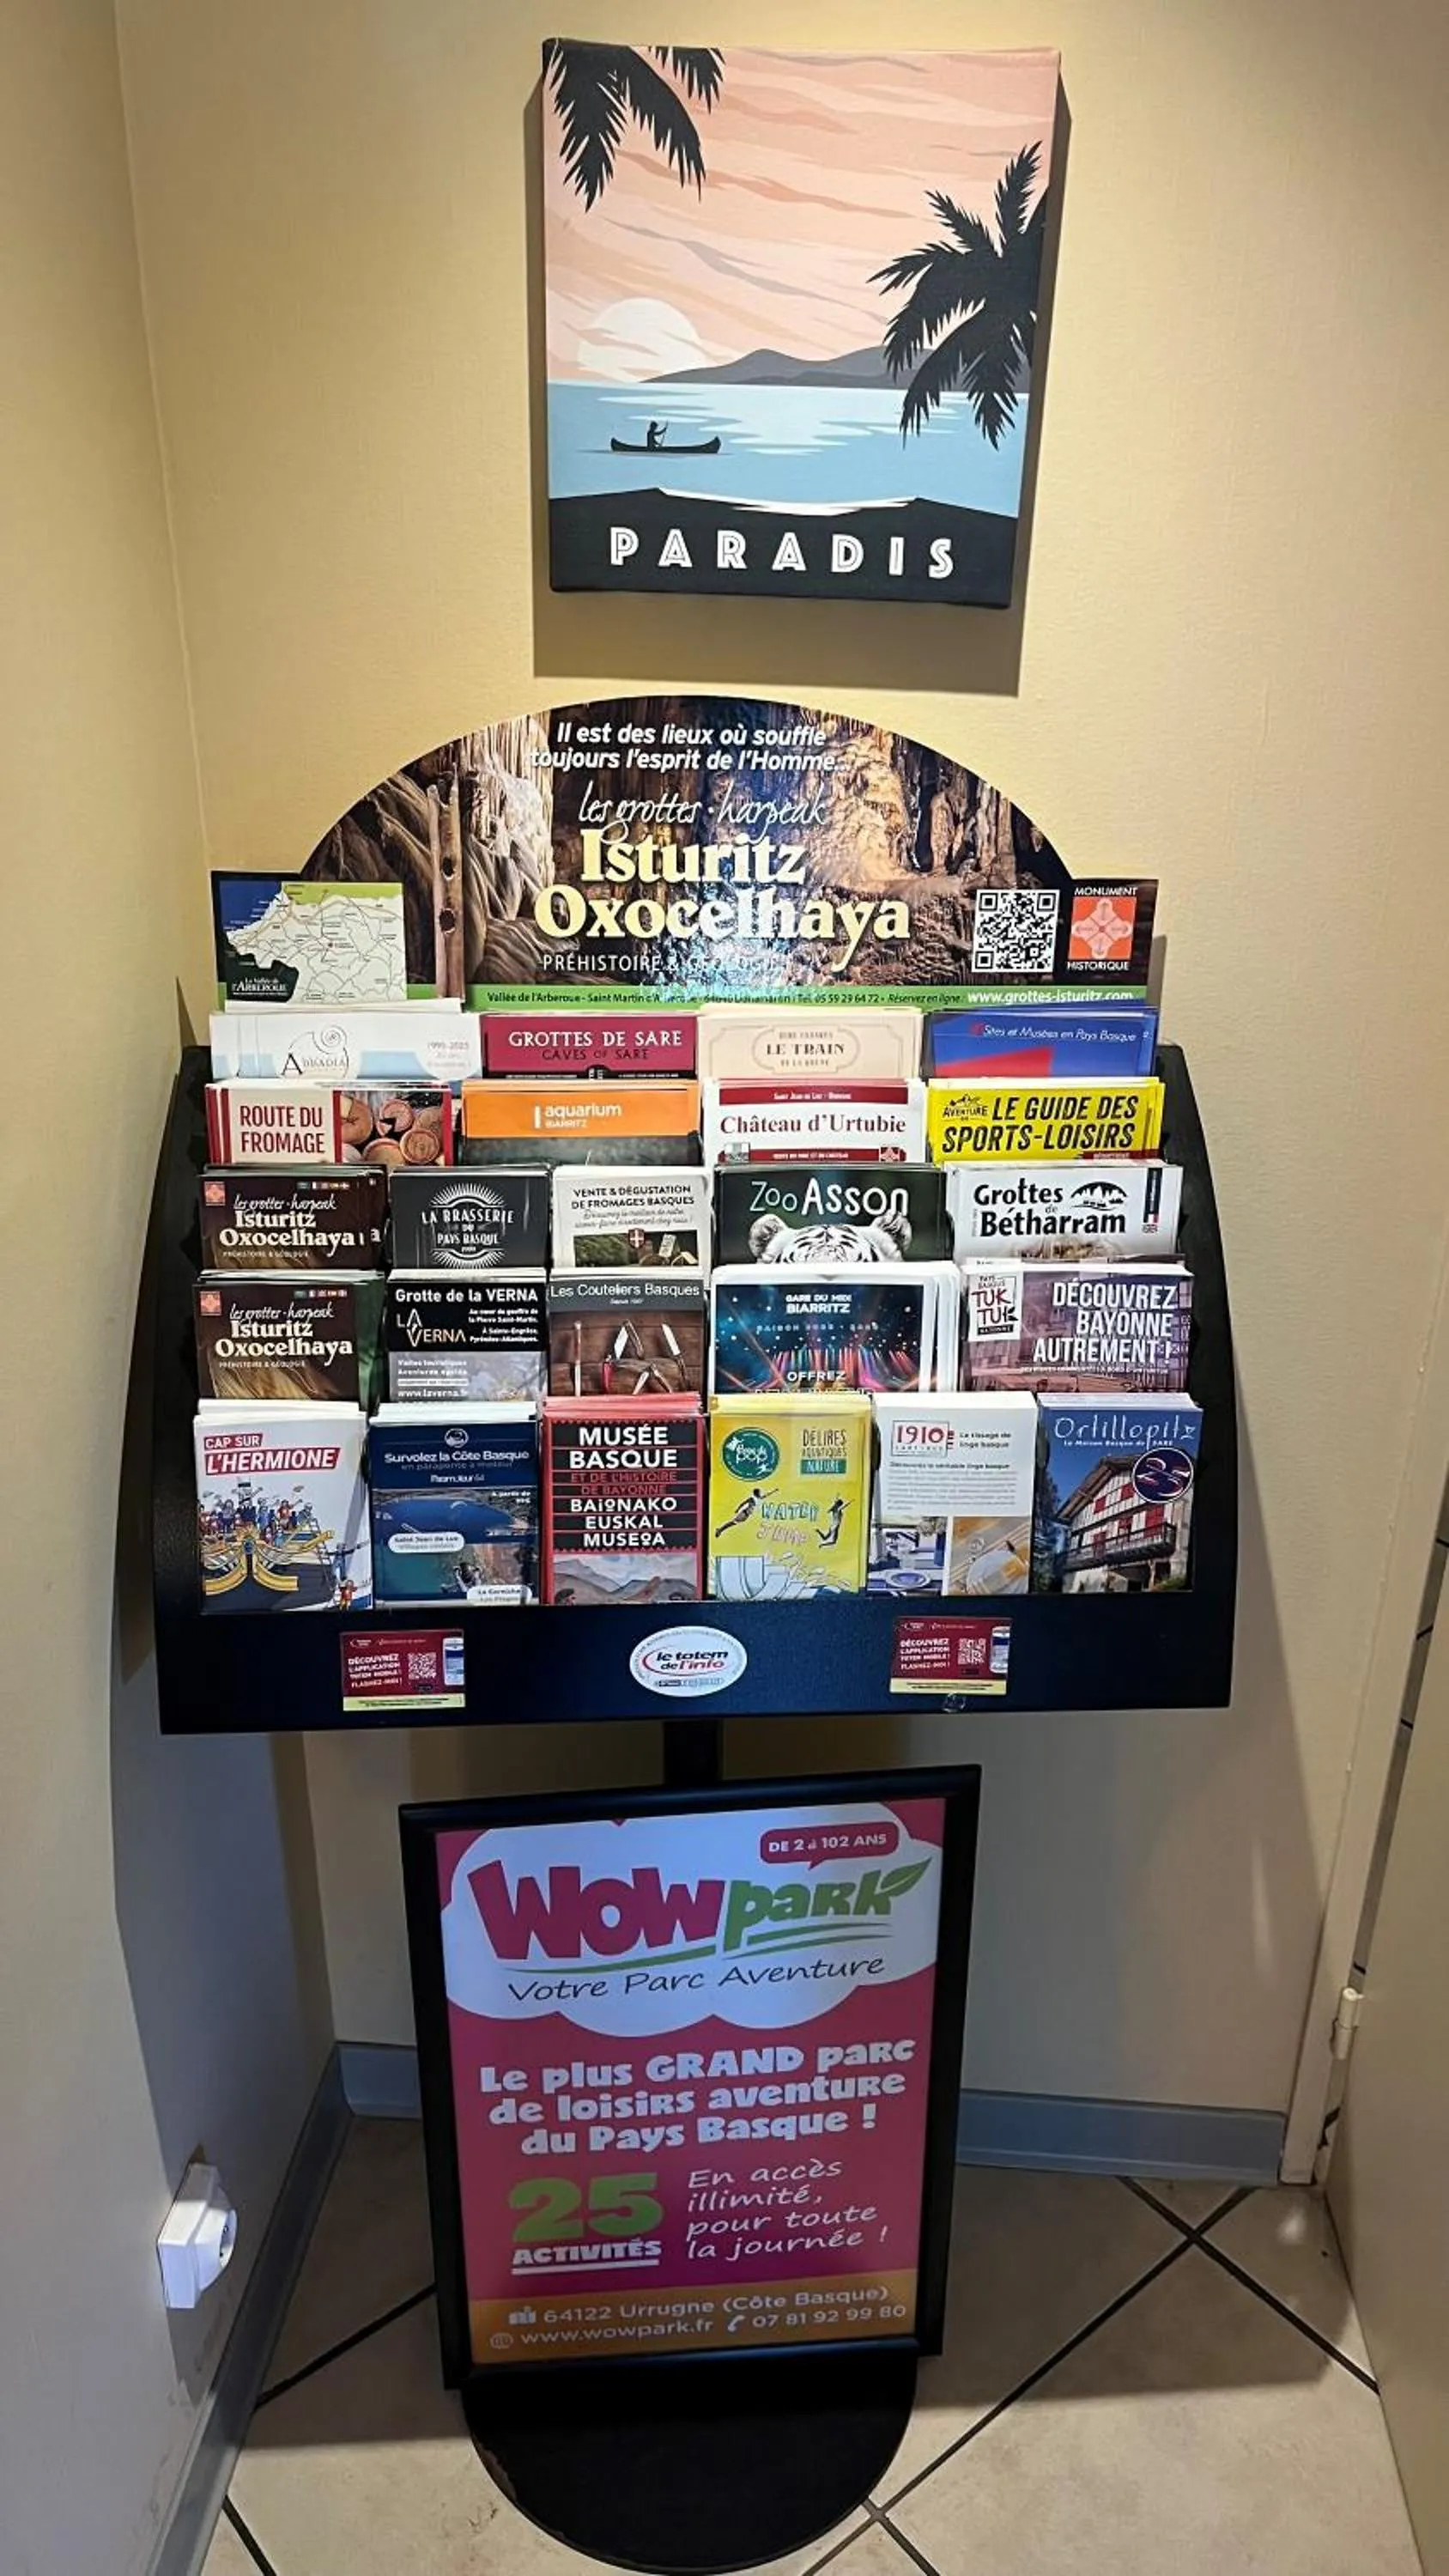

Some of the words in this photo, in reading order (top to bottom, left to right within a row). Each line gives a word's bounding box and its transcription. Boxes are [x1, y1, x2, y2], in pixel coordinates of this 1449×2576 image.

[610, 526, 954, 579] PARADIS
[557, 723, 570, 744] Il
[576, 726, 611, 744] est
[617, 724, 656, 744] des
[662, 724, 712, 745] lieux
[720, 726, 748, 745] où
[752, 726, 827, 747] souffle
[530, 749, 620, 772] toujours
[626, 750, 700, 772] l'esprit
[706, 751, 732, 770] de
[579, 781, 609, 823] les
[602, 792, 702, 845] grottes
[718, 779, 828, 846] harpeak
[580, 829, 806, 884] Isturitz
[1075, 886, 1137, 896] MONUMENT
[534, 885, 911, 973] Oxocelhaya
[543, 952, 661, 972] PRÉHISTOIRE
[1067, 961, 1129, 971] HISTORIQUE
[488, 992, 516, 1002] Vallée
[518, 992, 530, 1002] de
[588, 993, 611, 1003] Saint
[614, 993, 644, 1004] Martin
[828, 993, 839, 1003] 59
[868, 994, 879, 1004] 72
[967, 989, 1133, 1005] www.grottes-isturitz.com
[508, 1031, 592, 1047] GROTTES
[603, 1031, 625, 1047] DE
[634, 1030, 682, 1046] SARE
[1008, 1028, 1017, 1036] et
[1076, 1029, 1097, 1042] Pays
[1100, 1030, 1137, 1042] Basque
[542, 1049, 586, 1060] CAVES
[615, 1048, 649, 1060] SARE
[767, 1044, 786, 1055] LE
[791, 1044, 845, 1055] TRAIN
[239, 1106, 298, 1127] ROUTE
[300, 1107, 323, 1127] DU
[544, 1103, 622, 1118] aquarium
[992, 1097, 1019, 1121] LE
[1025, 1097, 1091, 1121] GUIDE
[1096, 1096, 1138, 1120] DES
[720, 1115, 801, 1134] Château
[809, 1114, 906, 1133] d'Urtubie
[240, 1132, 325, 1153] FROMAGE
[942, 1123, 1136, 1153] SPORTS-LOISIRS
[573, 1188, 607, 1198] VENTE
[619, 1186, 691, 1197] DÉGUSTATION
[749, 1181, 798, 1212] Zoo
[973, 1177, 1064, 1206] Grottes
[233, 1194, 247, 1210] les
[245, 1198, 284, 1216] grottes
[572, 1200, 585, 1210] DE
[587, 1199, 644, 1209] FROMAGES
[647, 1196, 694, 1206] BASQUES
[1045, 1204, 1058, 1214] de
[235, 1211, 316, 1228] Isturitz
[421, 1212, 438, 1224] LA
[443, 1209, 514, 1224] BRASSERIE
[979, 1208, 1126, 1237] Bétharram
[220, 1229, 355, 1258] Oxocelhaya
[437, 1233, 460, 1244] PAYS
[395, 1289, 441, 1303] Grotte
[446, 1289, 464, 1303] de
[469, 1289, 482, 1303] la
[486, 1288, 538, 1302] VERNA
[551, 1285, 573, 1297] Les
[578, 1283, 641, 1297] Couteliers
[646, 1283, 700, 1298] Basques
[971, 1289, 1011, 1307] TUK
[1052, 1279, 1177, 1309] DÉCOUVREZ
[230, 1303, 244, 1320] les
[241, 1308, 282, 1326] grottes
[786, 1303, 850, 1314] BIARRITZ
[397, 1309, 422, 1329] LA
[1076, 1309, 1173, 1336] BAYONNE
[231, 1321, 313, 1338] Isturitz
[407, 1329, 466, 1347] VERNA
[215, 1339, 353, 1366] Oxocelhaya
[1034, 1338, 1160, 1364] AUTREMENT
[787, 1371, 846, 1382] OFFREZ
[205, 1437, 231, 1449] CAP
[235, 1436, 260, 1447] SUR
[579, 1423, 669, 1446] MUSÉE
[803, 1429, 847, 1446] DÉLIRES
[897, 1425, 944, 1443] 1910
[208, 1449, 335, 1473] L'HERMIONE
[385, 1452, 437, 1463] Survolez
[439, 1451, 450, 1461] la
[452, 1450, 482, 1461] Côte
[482, 1450, 530, 1462] Basque
[569, 1449, 677, 1469] BASQUE
[571, 1473, 585, 1483] ET
[590, 1473, 608, 1483] DE
[611, 1471, 677, 1482] L'HISTOIRE
[581, 1485, 598, 1495] DE
[603, 1485, 666, 1495] BAYONNE
[585, 1515, 663, 1529] EUSKAL
[584, 1533, 665, 1546] MUSEOA
[900, 1637, 949, 1648] DÉCOUVREZ
[349, 1653, 399, 1665] DÉCOUVREZ
[657, 1651, 672, 1662] le
[676, 1651, 729, 1661] totem
[660, 1662, 678, 1670] de
[768, 1840, 790, 1853] DE
[793, 1839, 805, 1851] 2
[821, 1836, 850, 1850] 102
[852, 1833, 887, 1848] ANS
[508, 1977, 609, 2002] Votre
[623, 1971, 706, 1995] Parc
[718, 1955, 886, 1988] Aventure
[480, 2067, 528, 2093] Le
[542, 2061, 633, 2094] plus
[646, 2045, 804, 2081] GRAND
[489, 2097, 544, 2125] de
[521, 2129, 576, 2155] du
[589, 2121, 685, 2154] Pays
[697, 2109, 849, 2144] Basque
[862, 2103, 876, 2129] !
[688, 2170, 734, 2188] En
[749, 2157, 842, 2183] accès
[509, 2172, 664, 2243] 25
[688, 2183, 822, 2213] illimité,
[687, 2215, 771, 2242] pour
[785, 2204, 878, 2228] toute
[513, 2237, 662, 2267] ACTIVITÉS
[688, 2238, 717, 2259] la
[727, 2230, 864, 2263] journée
[878, 2226, 888, 2244] !
[543, 2306, 611, 2324] 64122
[619, 2299, 714, 2322] Urrugne
[723, 2293, 786, 2313] (Côte
[795, 2285, 889, 2307] Basque)
[520, 2319, 713, 2344] www.wowpark.fr
[753, 2313, 779, 2328] 07
[785, 2312, 807, 2325] 81
[810, 2310, 839, 2324] 92
[846, 2306, 873, 2323] 99
[878, 2305, 906, 2320] 80
